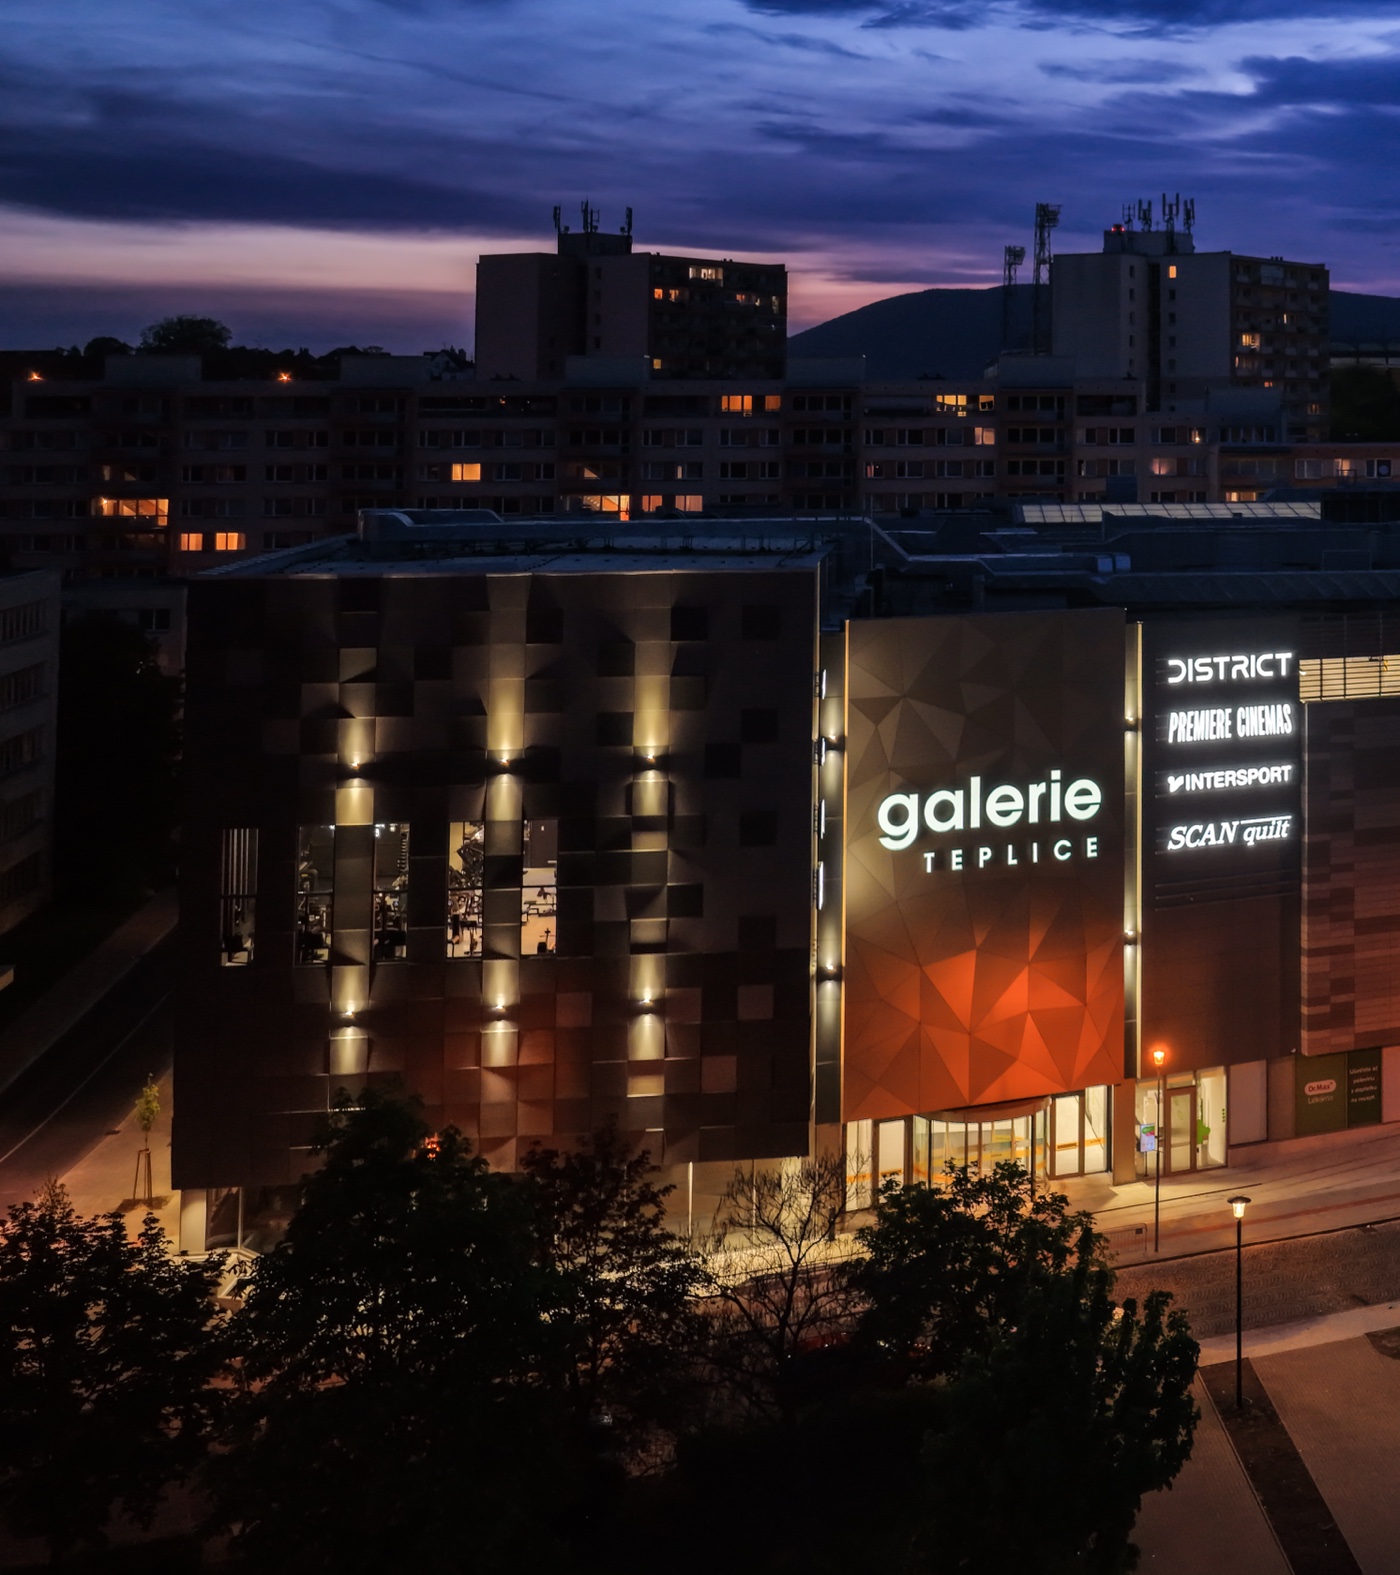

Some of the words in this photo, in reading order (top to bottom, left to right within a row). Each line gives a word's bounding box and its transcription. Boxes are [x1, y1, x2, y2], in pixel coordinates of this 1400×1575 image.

[1167, 652, 1293, 684] DISTRICT
[1167, 708, 1232, 743] PREMIERE
[1236, 704, 1293, 738] CINEMAS
[1185, 765, 1293, 791] INTERSPORT
[877, 769, 1102, 851] galerie
[1167, 821, 1238, 850] SCAN
[1242, 819, 1291, 846] quilt
[923, 836, 1098, 873] TEPLICE
